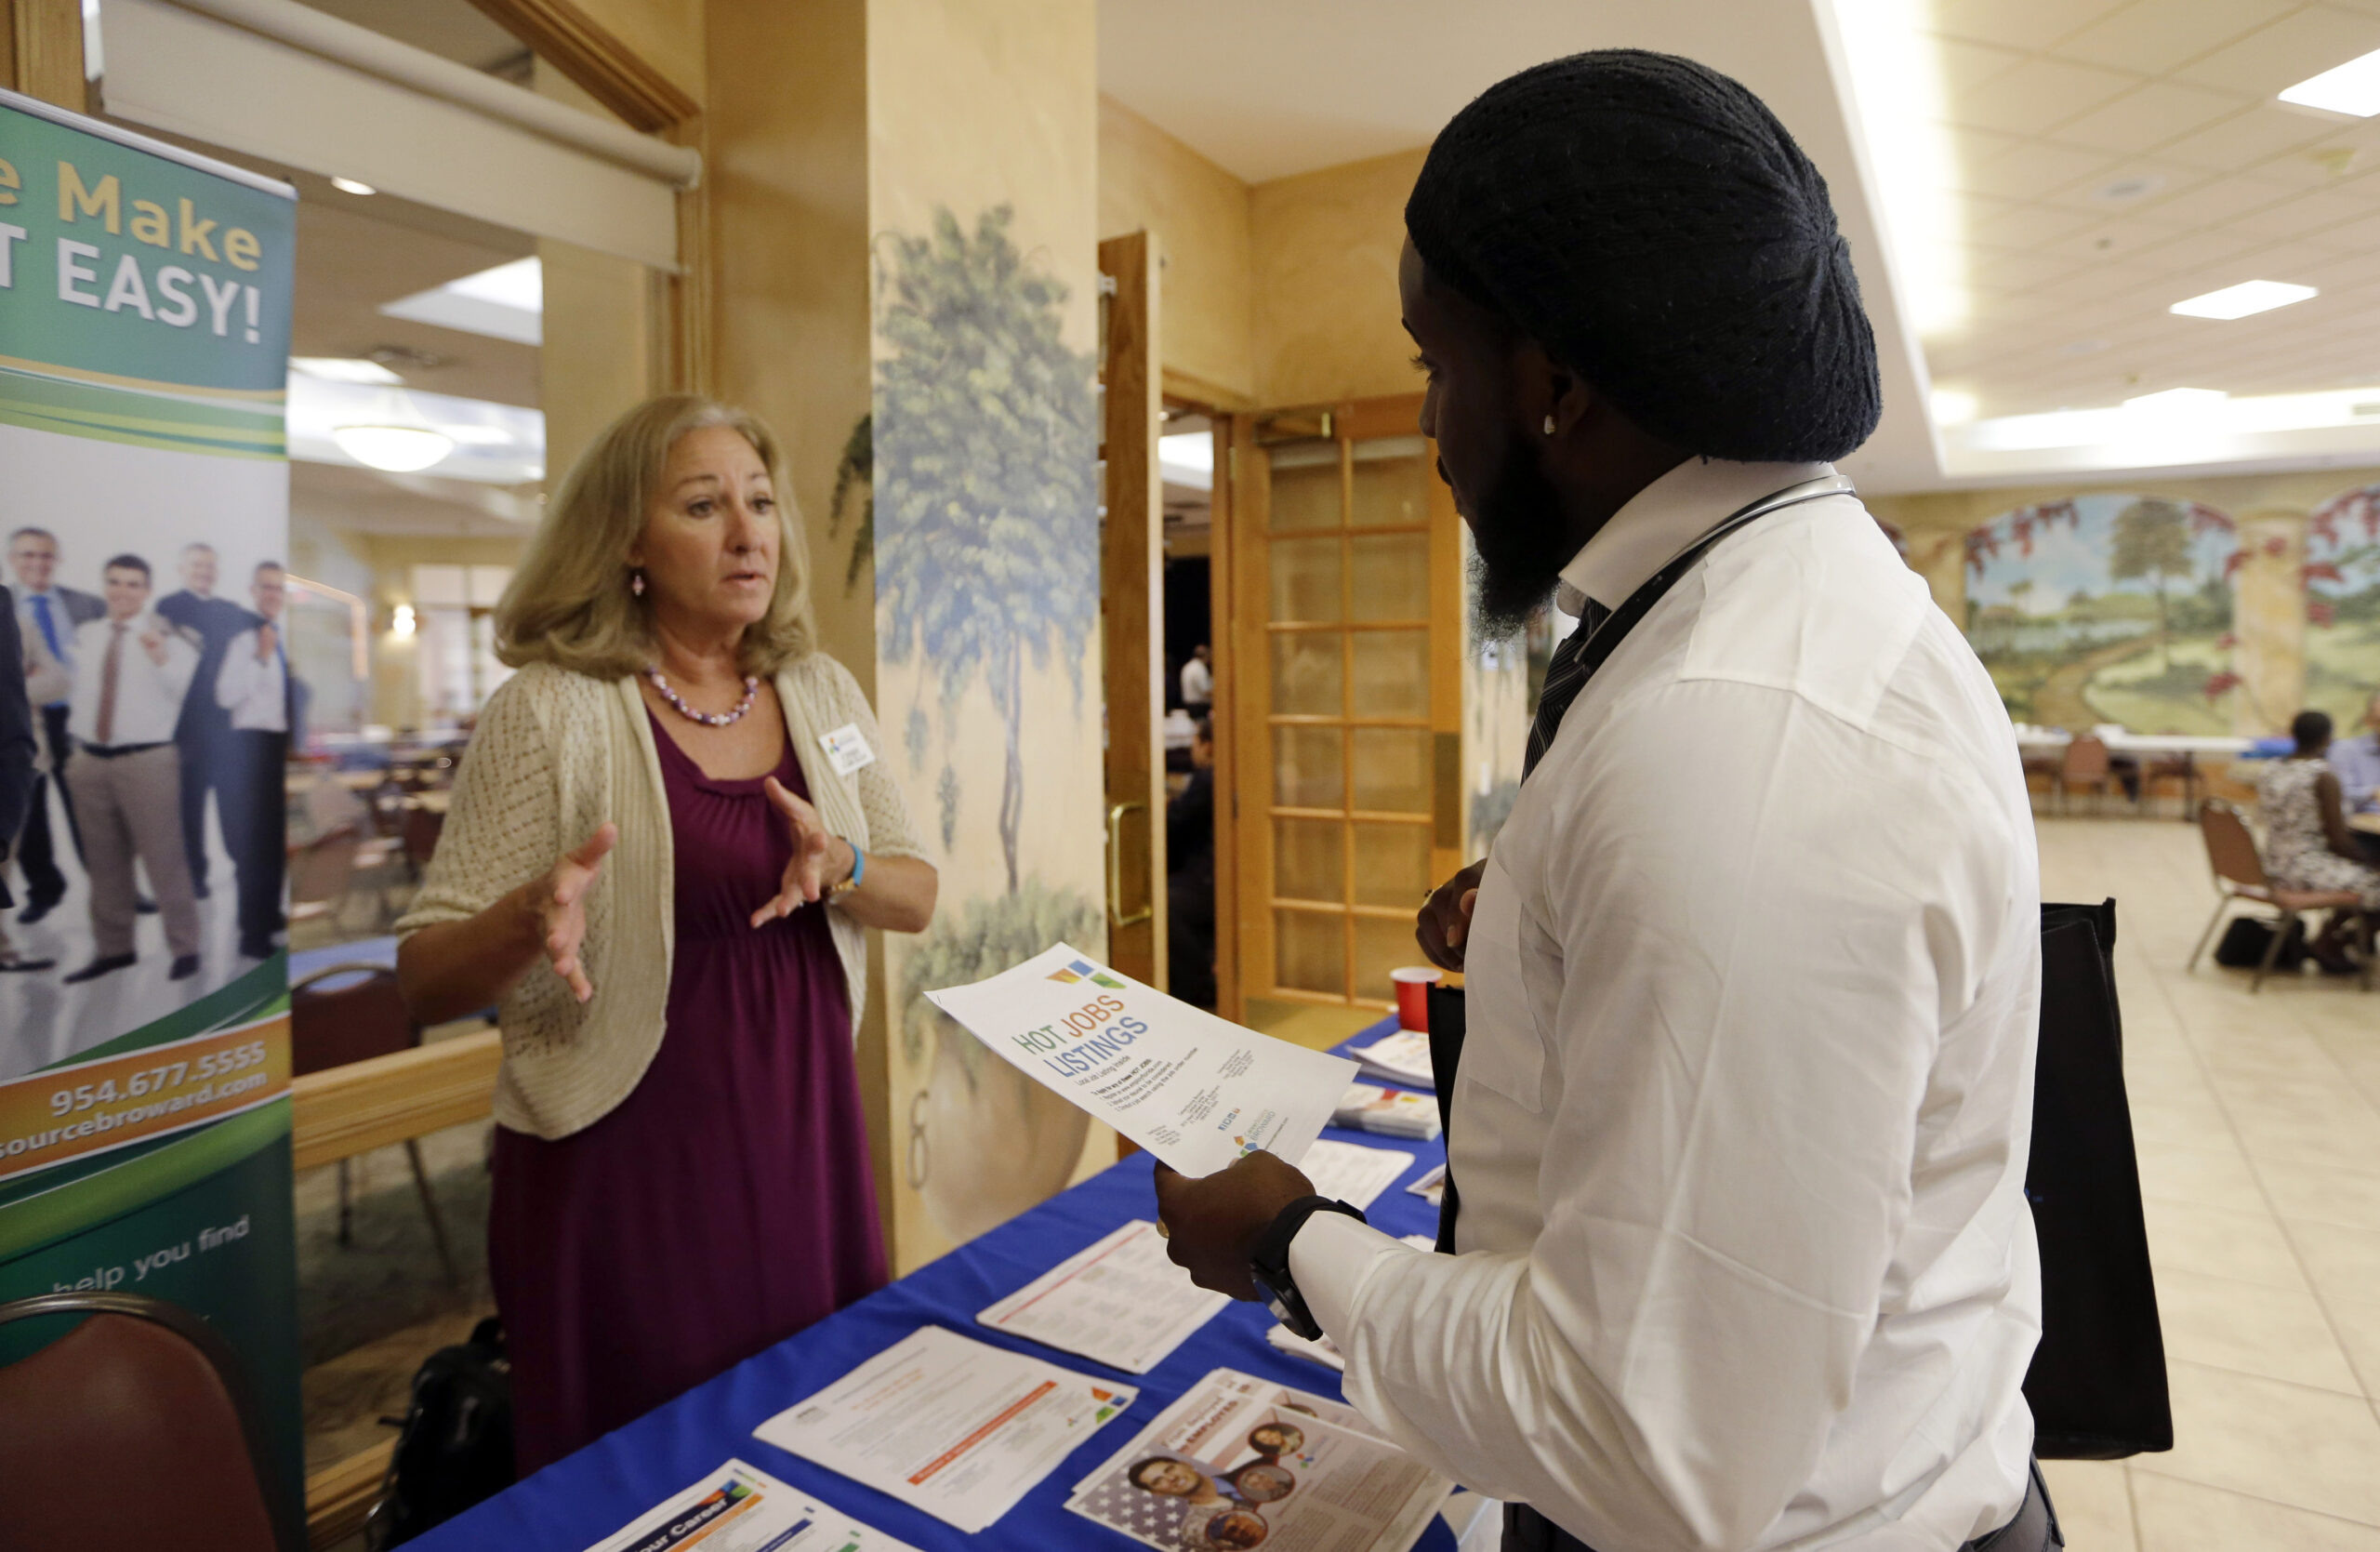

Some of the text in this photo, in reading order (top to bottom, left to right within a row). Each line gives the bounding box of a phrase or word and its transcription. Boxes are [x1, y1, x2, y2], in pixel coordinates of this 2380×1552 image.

[58, 160, 262, 272] Make
[58, 237, 260, 345] EASY!
[1012, 995, 1124, 1055] HOT JOBS
[1043, 1016, 1148, 1078] LISTINGS
[50, 1041, 267, 1117] 954.677.5555
[134, 1241, 191, 1280] you
[197, 1214, 250, 1253] find
[669, 1498, 728, 1536] Career
